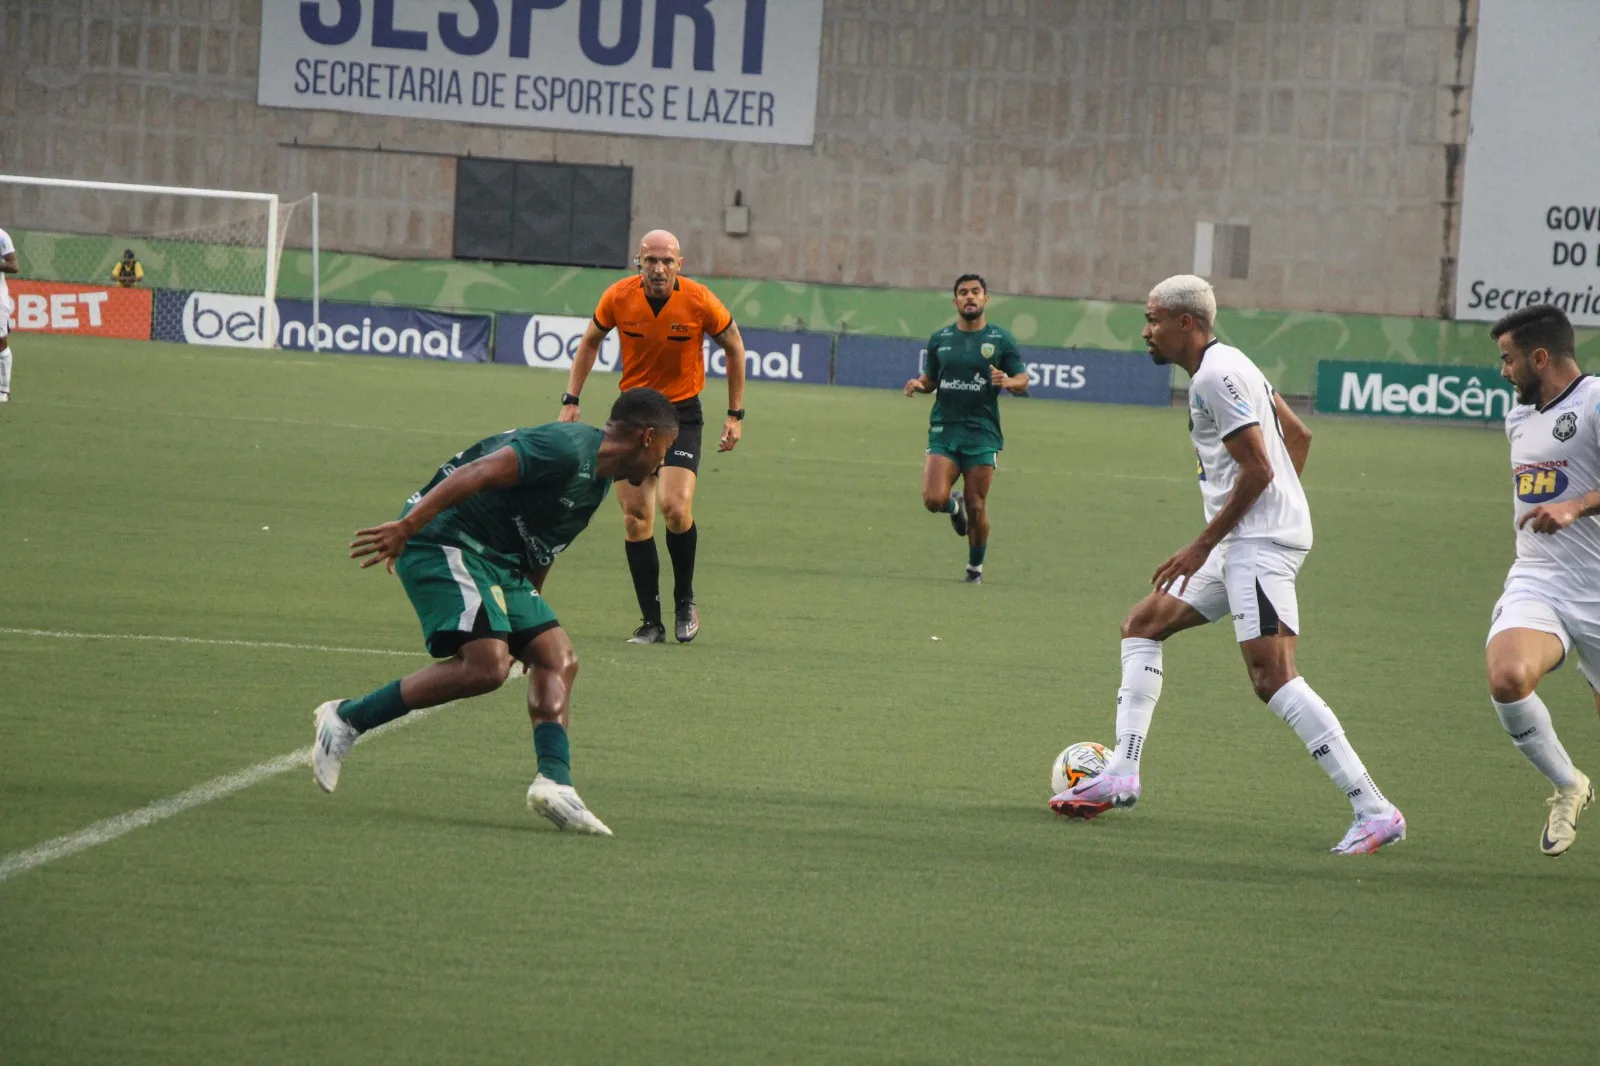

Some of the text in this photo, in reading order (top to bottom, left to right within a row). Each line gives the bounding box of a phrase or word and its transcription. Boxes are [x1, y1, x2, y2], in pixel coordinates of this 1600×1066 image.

[295, 58, 775, 127] SECRETARIA DE ESPORTES E LAZER
[1547, 205, 1600, 231] GOV
[1553, 241, 1587, 266] DO
[283, 318, 463, 357] nacional
[703, 339, 803, 379] ional
[1023, 363, 1086, 389] STES
[1339, 371, 1519, 418] MedSêni
[1519, 470, 1556, 495] BH
